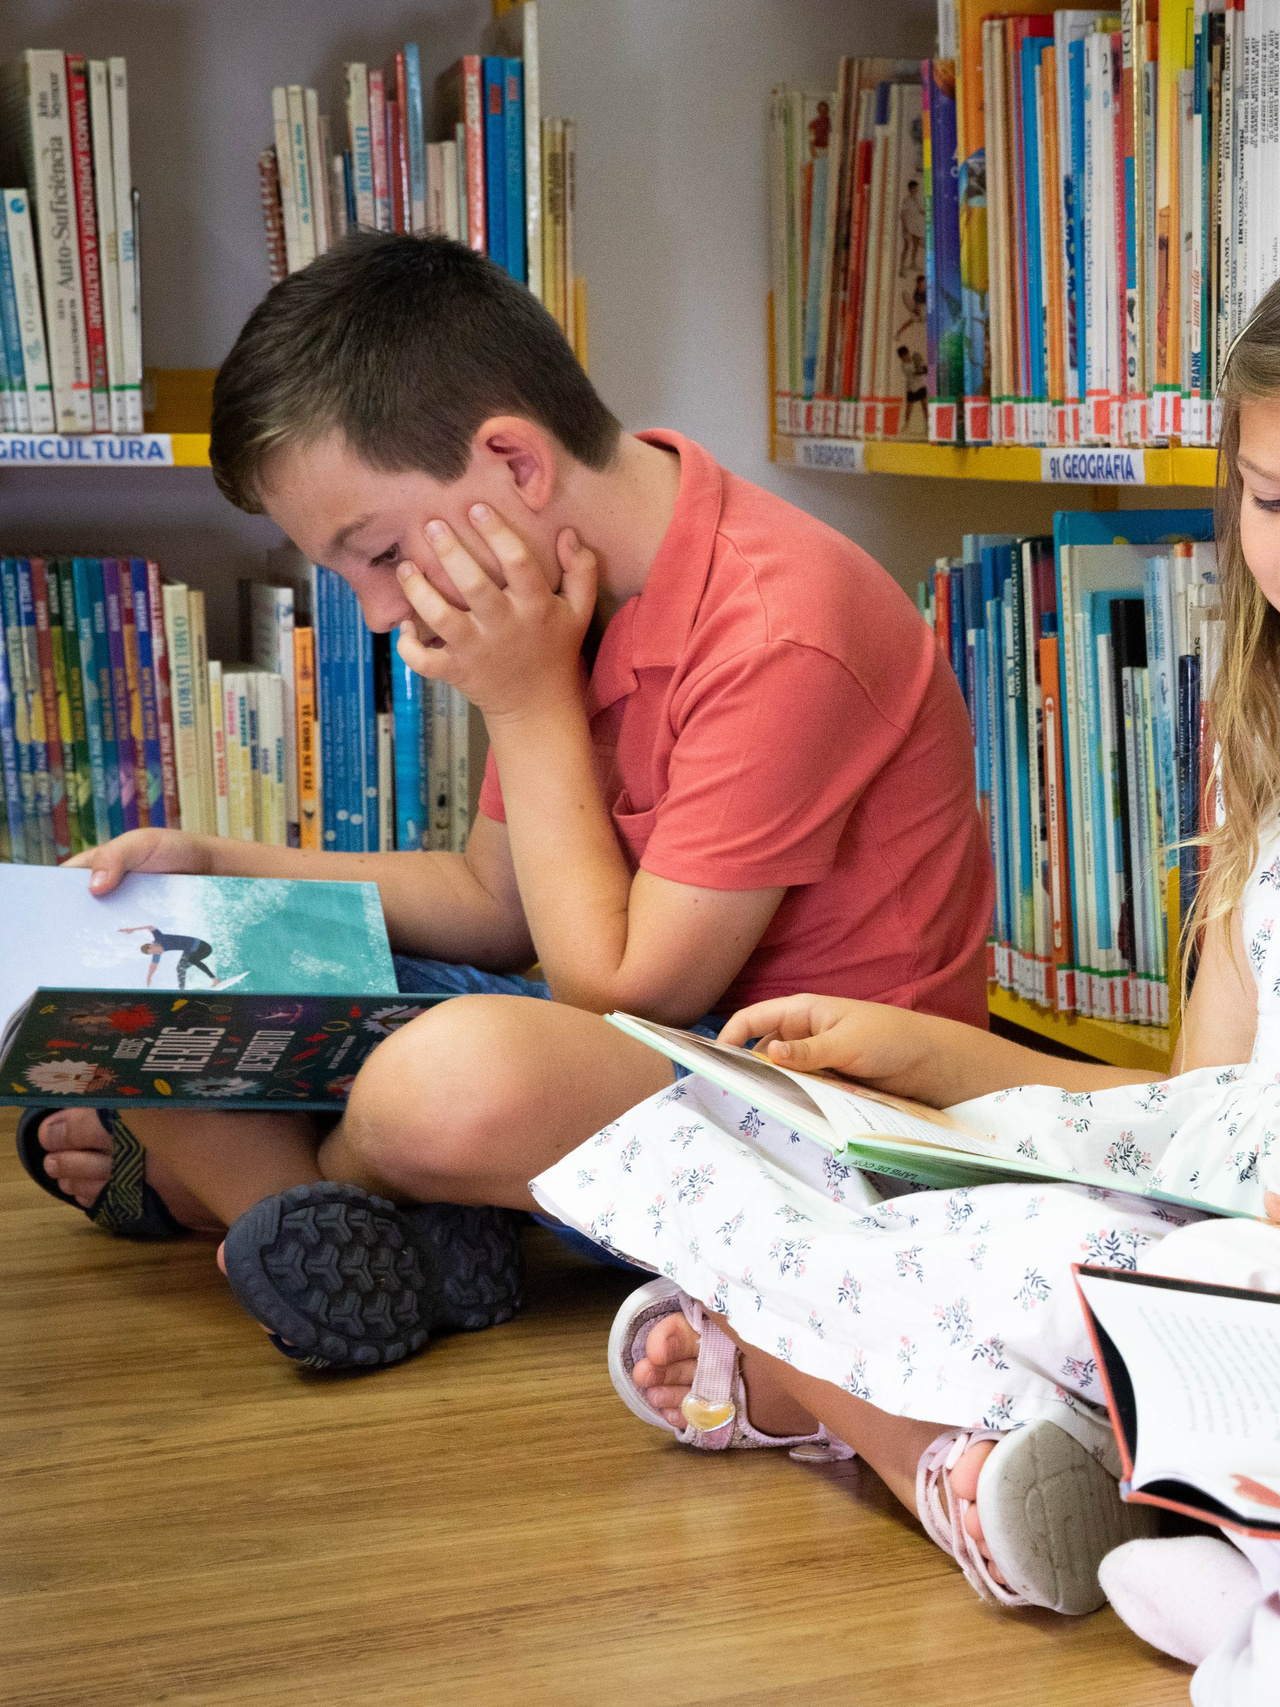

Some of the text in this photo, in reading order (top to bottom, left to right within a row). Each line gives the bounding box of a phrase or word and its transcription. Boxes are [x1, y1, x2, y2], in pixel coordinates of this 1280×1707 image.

[46, 136, 75, 291] Auto-Suficiência
[86, 249, 101, 329] CULTIVAR
[1191, 270, 1201, 388] FRANK uma vida
[1050, 454, 1135, 480] 91 GEOGRAFIA
[176, 665, 192, 708] LIVRO
[178, 711, 193, 728] DE
[140, 1027, 226, 1072] HERÓIS
[233, 1030, 295, 1072] DESPORTO
